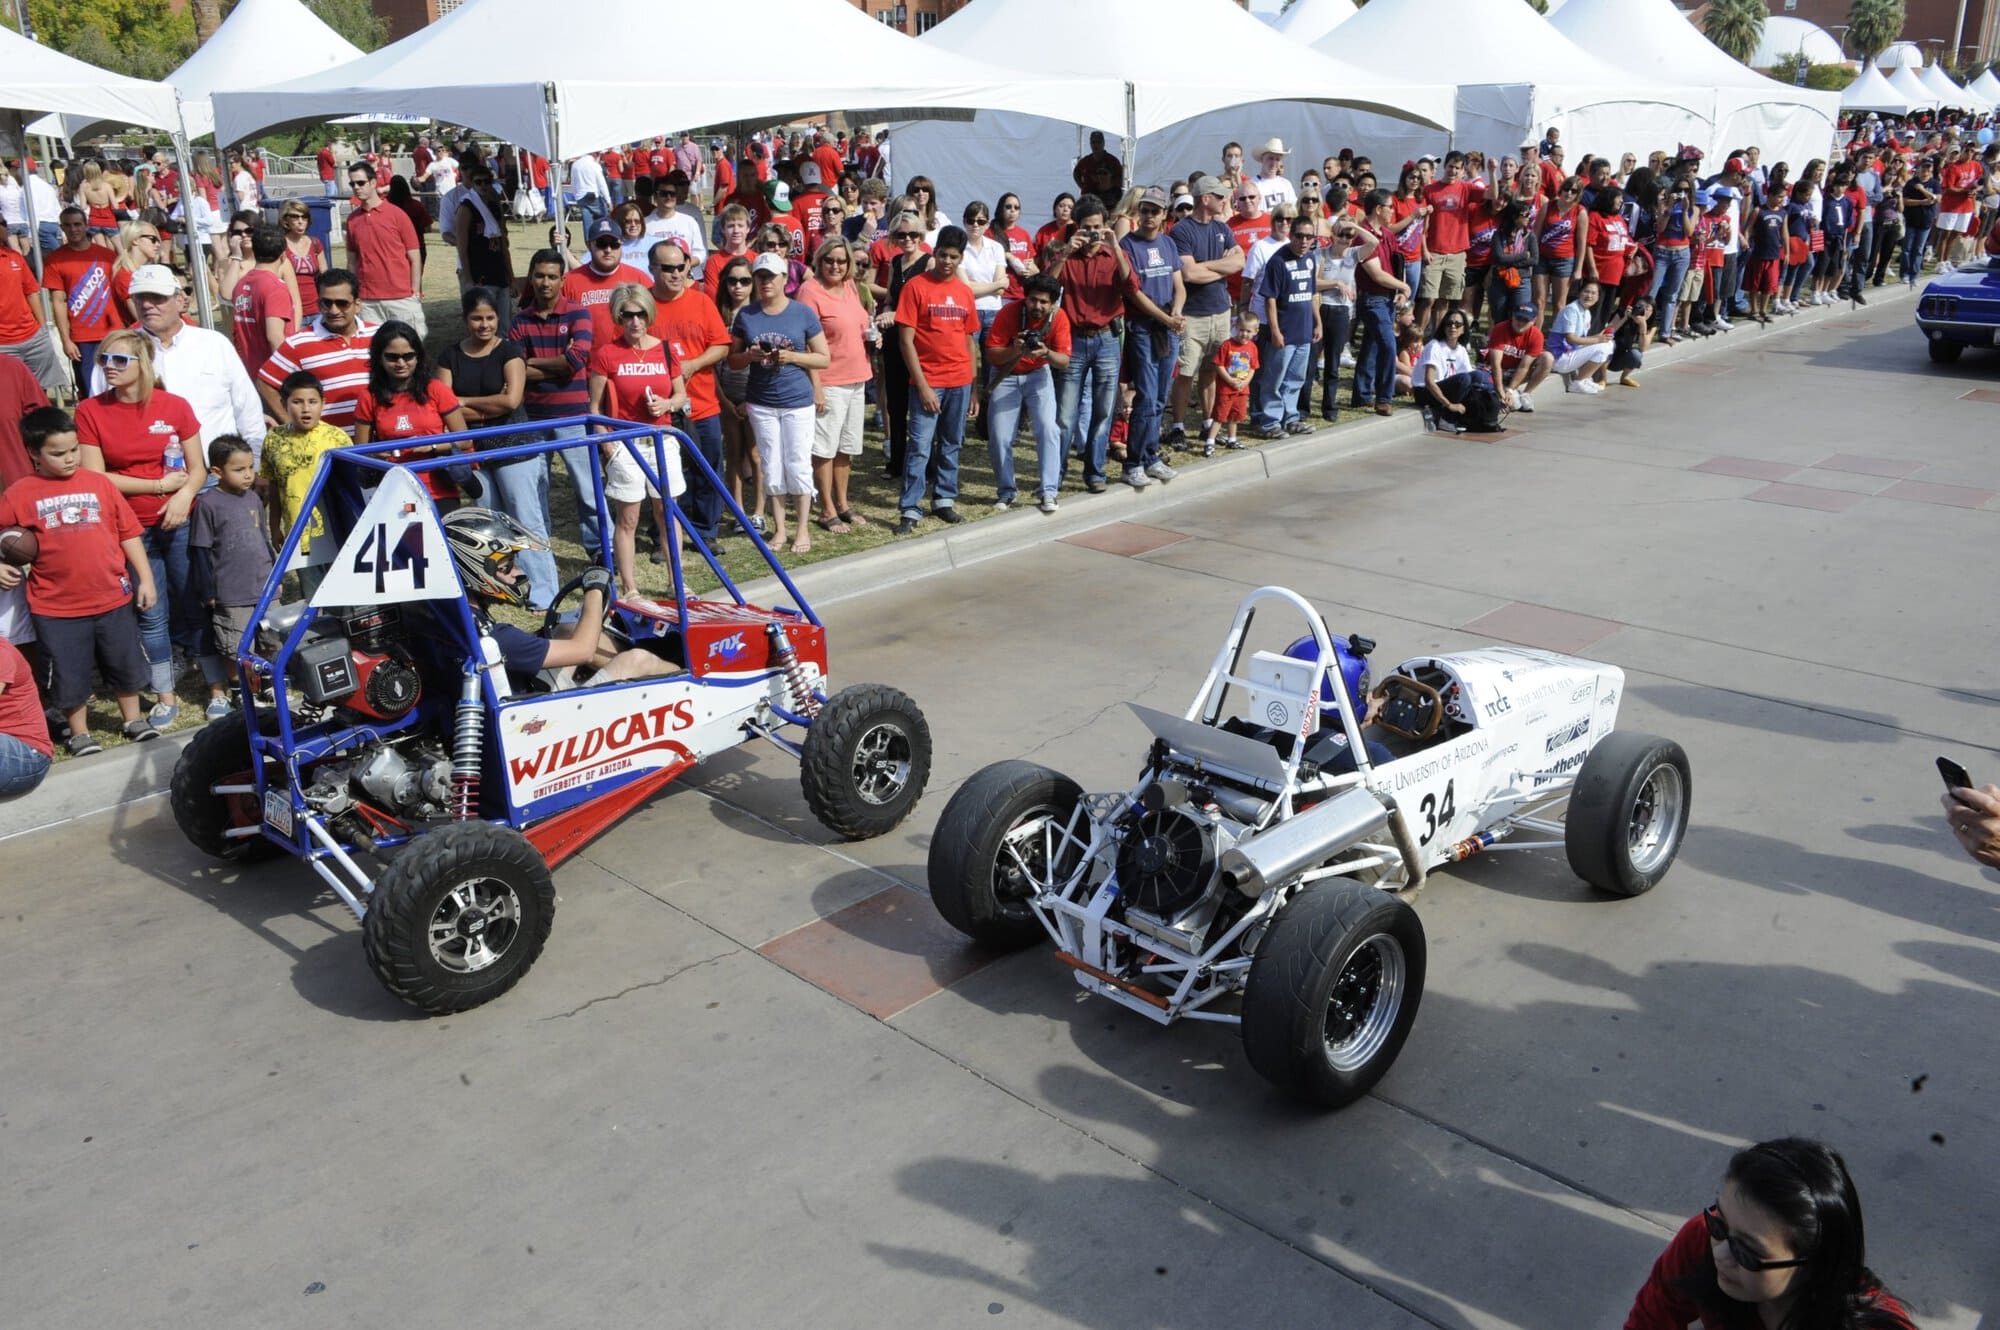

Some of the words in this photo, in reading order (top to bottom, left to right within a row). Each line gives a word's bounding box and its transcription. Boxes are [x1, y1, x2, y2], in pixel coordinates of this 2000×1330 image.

[1835, 206, 1844, 226] 1
[581, 289, 610, 307] ARIZ
[1288, 293, 1312, 303] ARIZO
[1298, 282, 1308, 291] OF
[617, 362, 667, 376] ARIZONA
[353, 521, 429, 593] 44
[707, 631, 747, 658] FOX
[1301, 689, 1319, 738] ARIZONA
[1485, 695, 1511, 718] ITCE
[509, 698, 695, 786] WILDCATS
[533, 774, 582, 799] UNIVERSITY
[586, 770, 596, 781] OF
[599, 758, 633, 777] ARIZONA
[1377, 779, 1393, 795] THE
[1441, 753, 1452, 771] OF
[1533, 749, 1588, 788] Raytheon
[1419, 777, 1456, 848] 34
